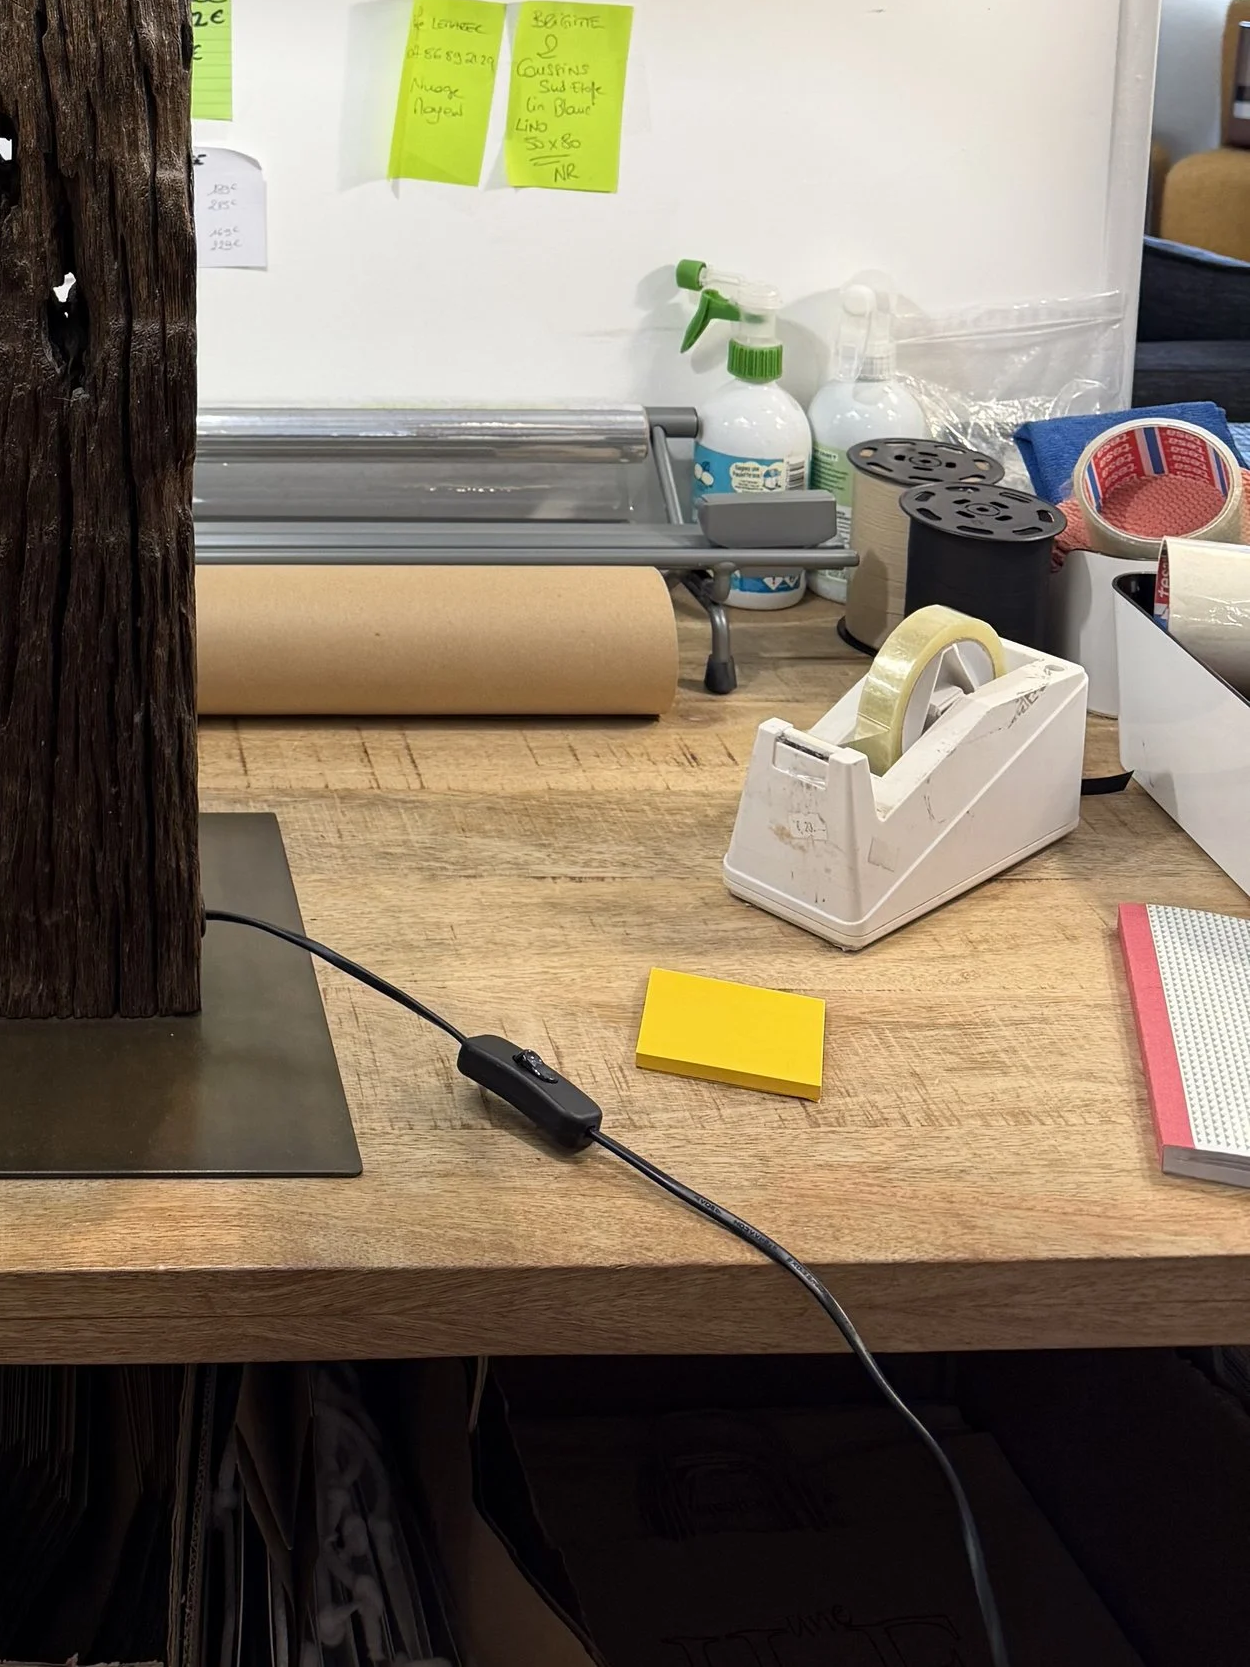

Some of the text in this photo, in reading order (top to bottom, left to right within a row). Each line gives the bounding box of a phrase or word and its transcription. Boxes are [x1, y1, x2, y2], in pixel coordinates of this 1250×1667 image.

[539, 80, 567, 94] Sud
[554, 98, 591, 118] Blanc
[554, 163, 580, 183] NR
[1097, 433, 1129, 457] tesa
[1166, 429, 1201, 444] tesa
[1169, 438, 1204, 453] tesa
[1100, 443, 1133, 467] tesa
[1170, 446, 1207, 462] tesa
[1102, 453, 1135, 478] tesa
